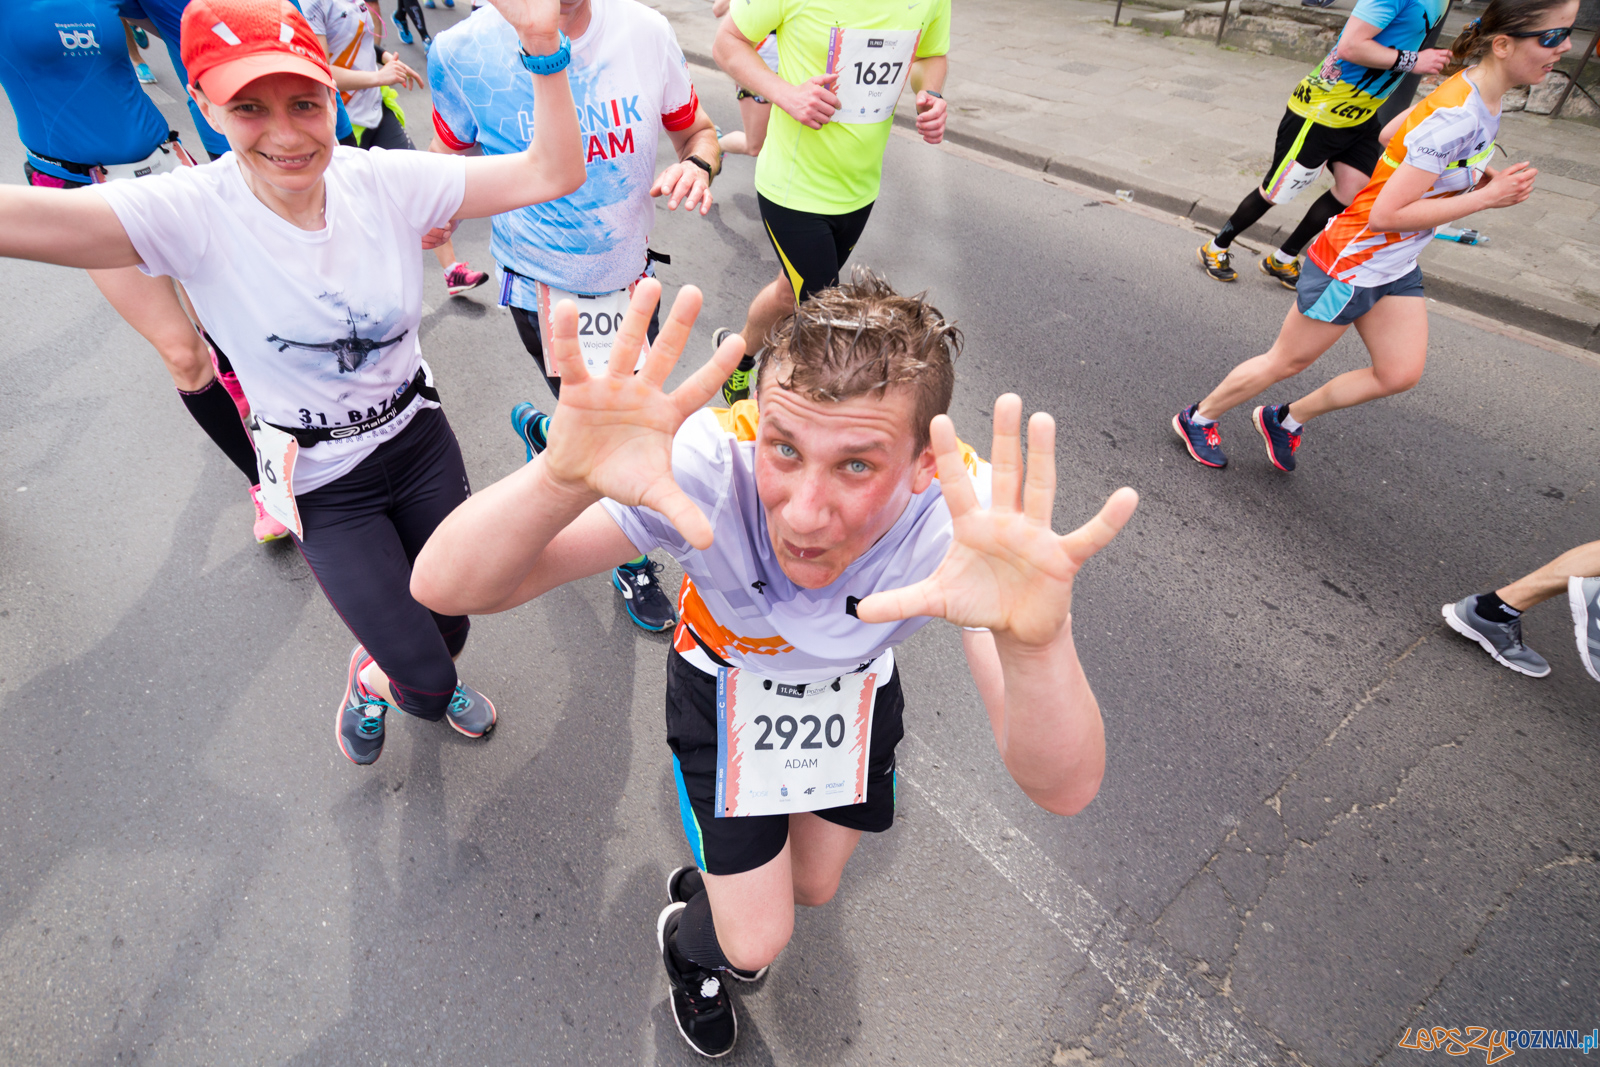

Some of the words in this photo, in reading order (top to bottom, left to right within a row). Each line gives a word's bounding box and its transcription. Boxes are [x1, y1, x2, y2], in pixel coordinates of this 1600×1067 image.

[854, 61, 903, 85] 1627
[868, 90, 883, 98] Piotr
[583, 341, 613, 349] Wojciec
[362, 407, 397, 431] Kalenji
[753, 713, 846, 751] 2920
[784, 758, 818, 769] ADAM
